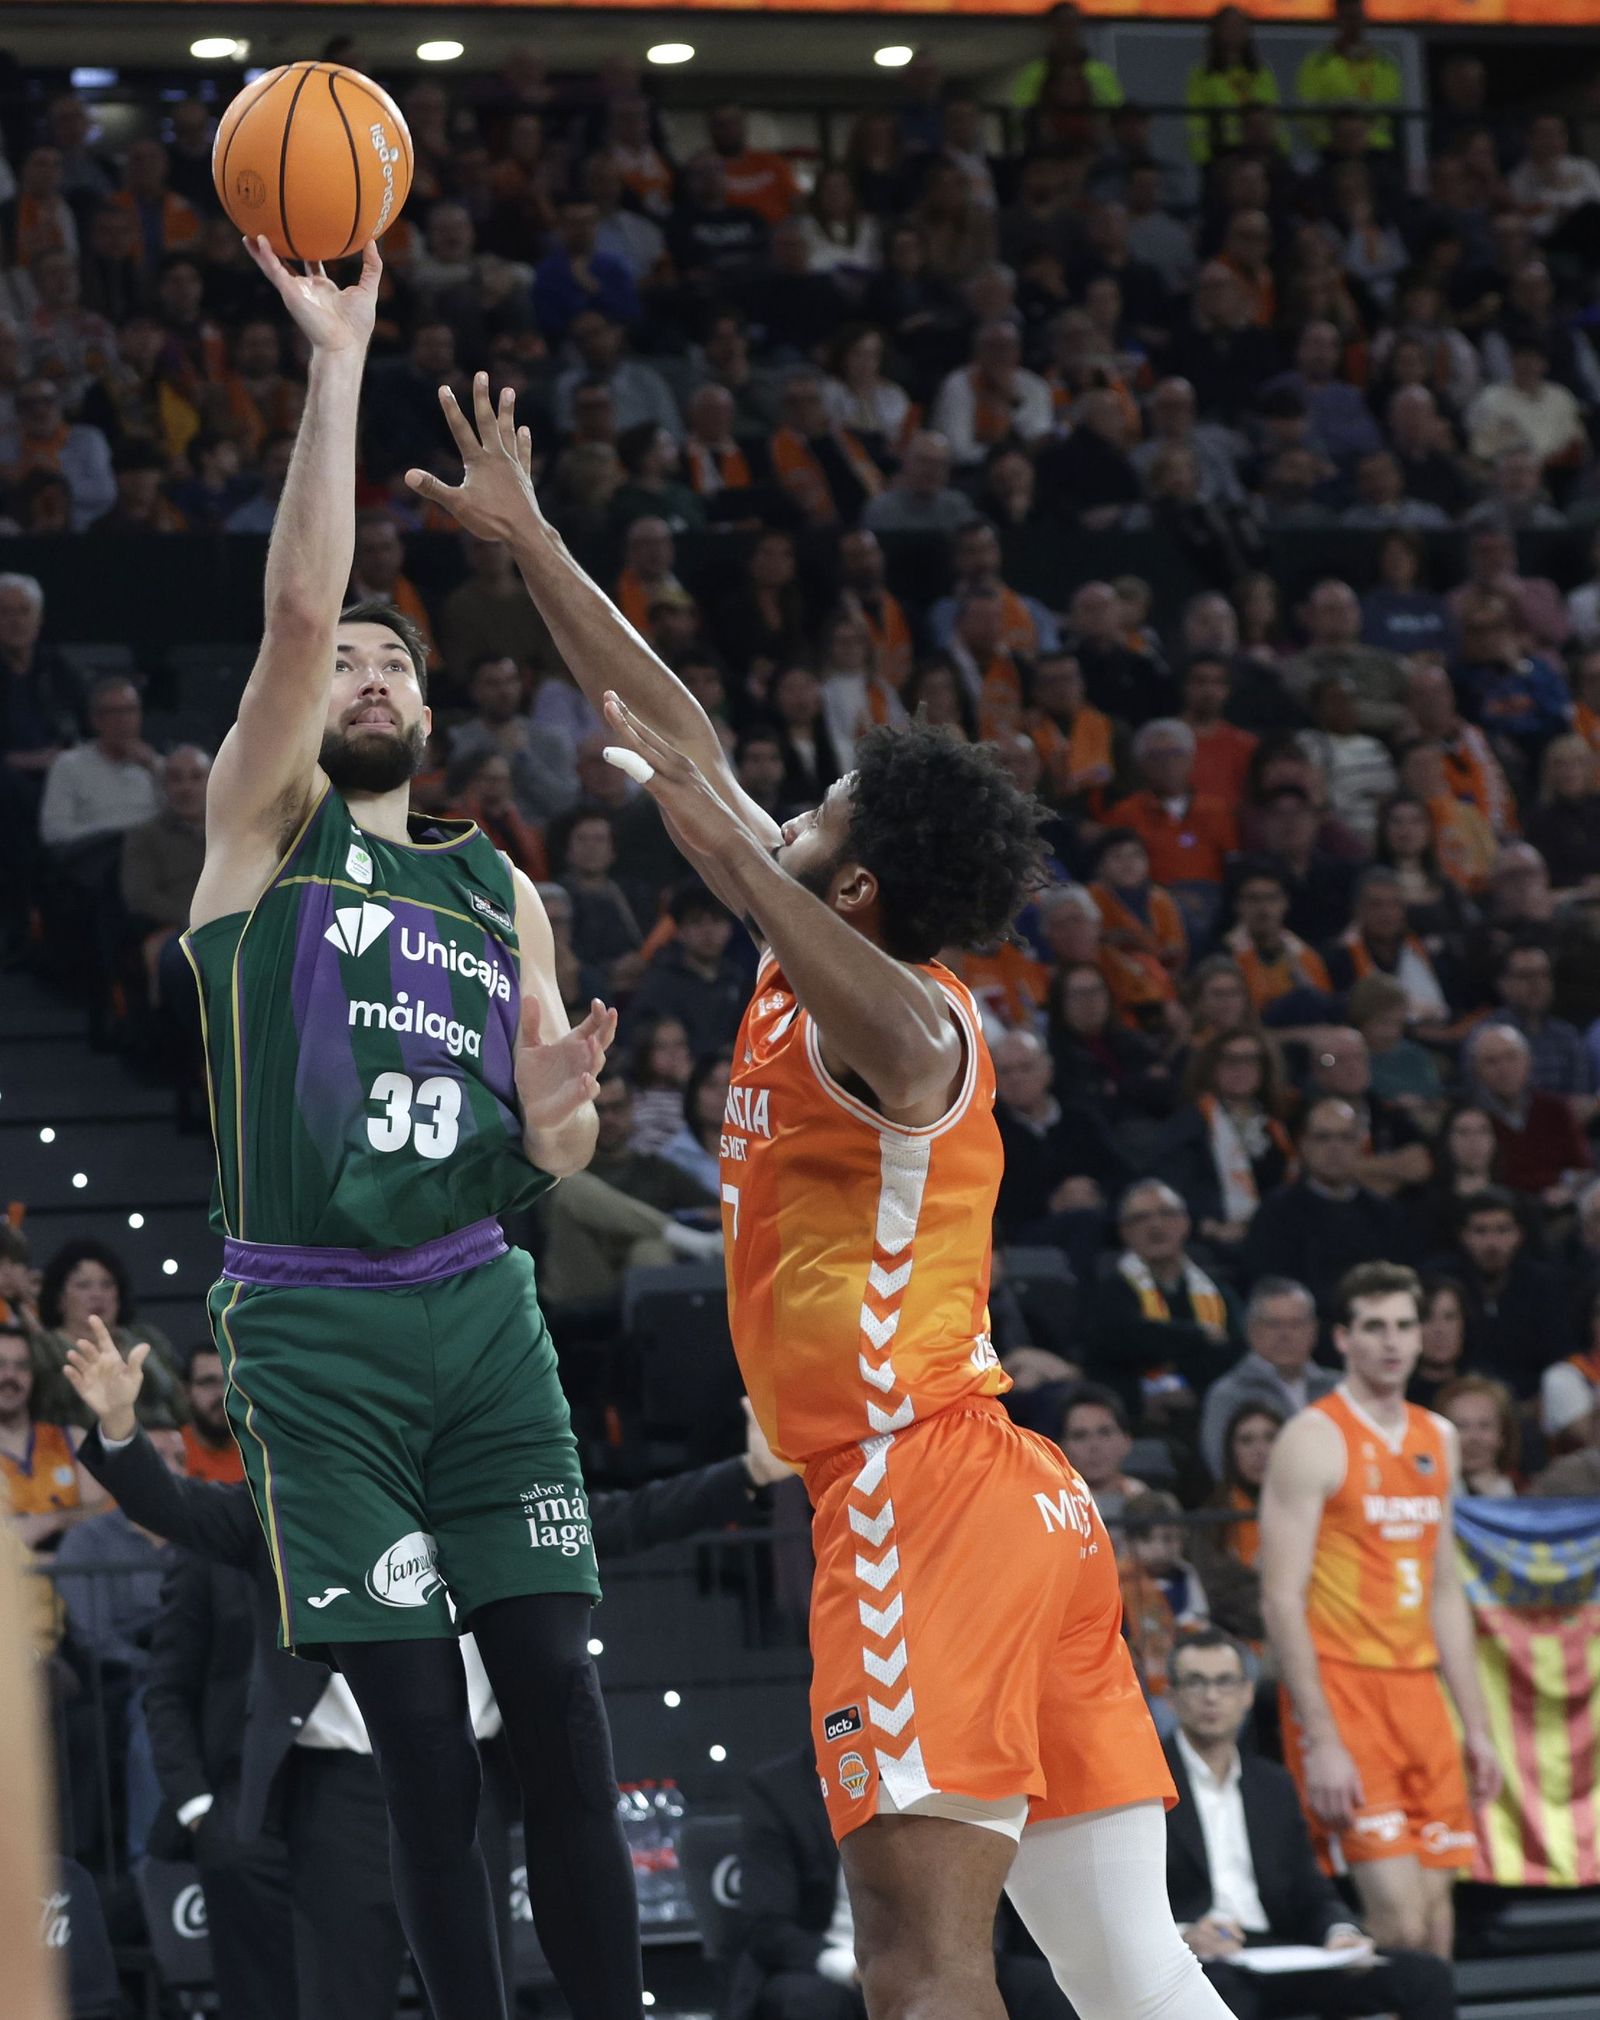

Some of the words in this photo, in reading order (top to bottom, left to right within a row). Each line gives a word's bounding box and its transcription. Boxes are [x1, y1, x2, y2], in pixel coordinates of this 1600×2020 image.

[401, 927, 512, 1001] Unicaja
[348, 991, 482, 1058] málaga
[366, 1071, 462, 1159] 33
[722, 1183, 739, 1240] 7
[519, 1483, 565, 1502] sabor
[523, 1504, 535, 1514] a
[535, 1487, 588, 1521] má
[526, 1517, 590, 1557] laga
[827, 1718, 853, 1737] acb
